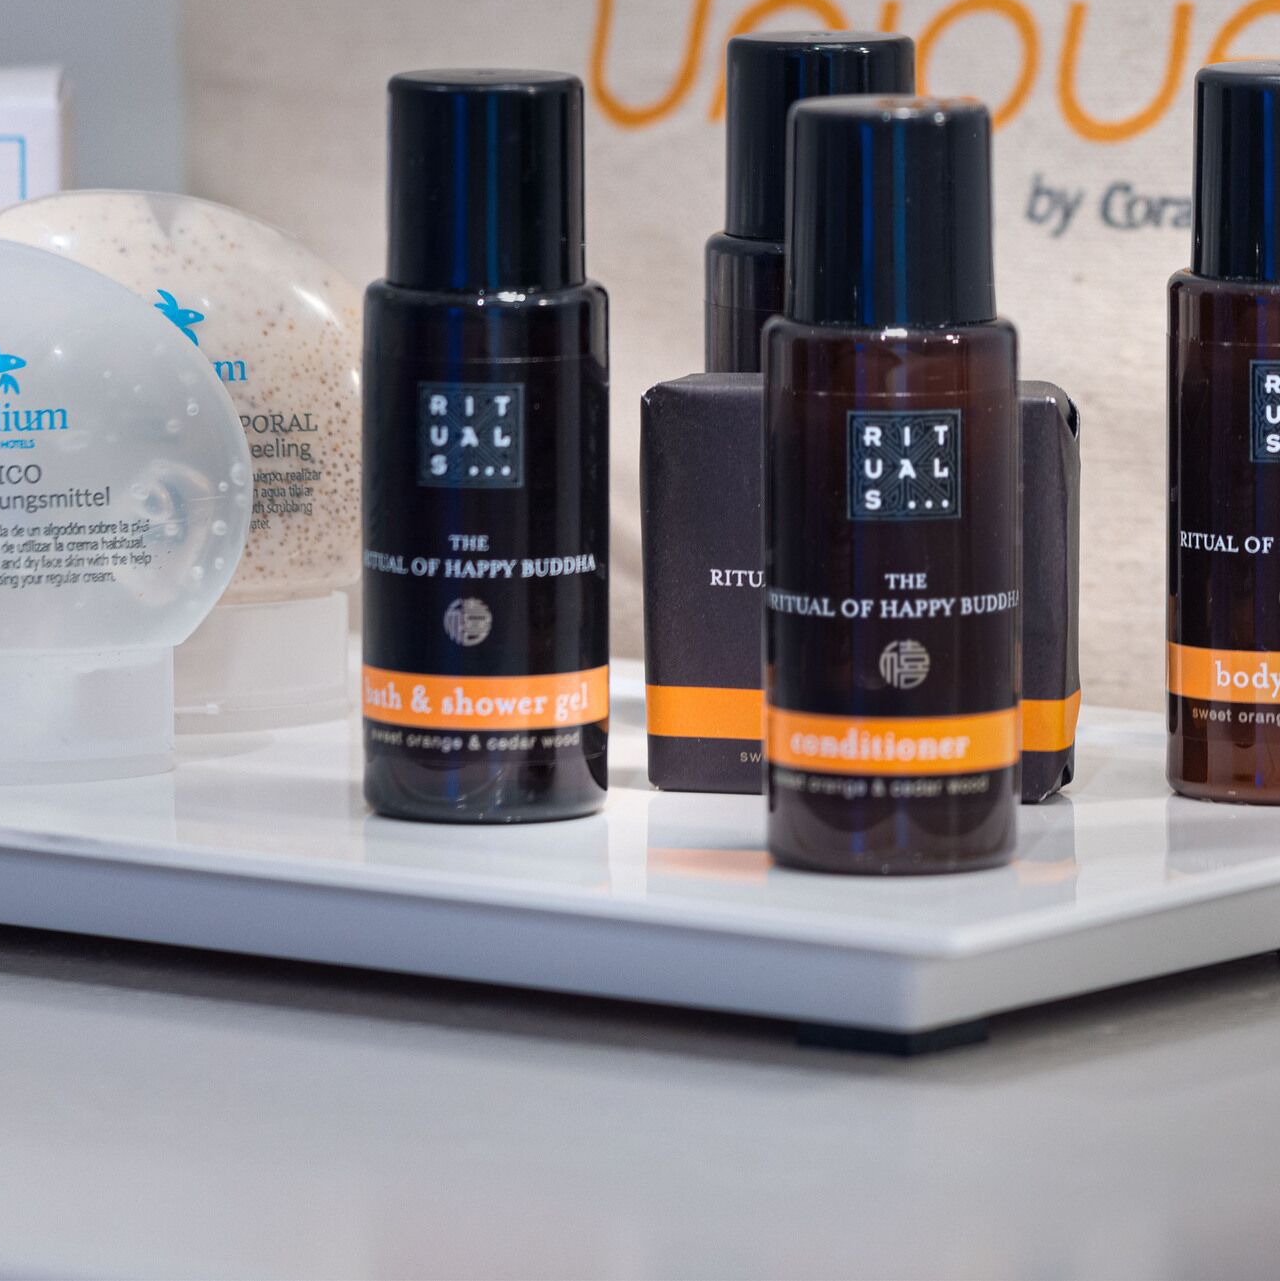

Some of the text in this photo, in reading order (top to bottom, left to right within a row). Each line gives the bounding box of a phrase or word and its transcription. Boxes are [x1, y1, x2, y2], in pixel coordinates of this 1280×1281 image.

[1025, 172, 1085, 238] by
[448, 534, 489, 551] THE
[1180, 531, 1239, 552] RITUAL
[1244, 537, 1273, 554] OF
[411, 557, 440, 577] OF
[444, 559, 519, 578] HAPPY
[521, 553, 596, 578] BUDDHA
[710, 569, 768, 587] RITU
[884, 573, 927, 589] THE
[841, 598, 873, 618] OF
[880, 598, 955, 618] HAPPY
[411, 684, 432, 714] &
[441, 686, 548, 716] shower
[555, 682, 588, 721] gel
[1192, 707, 1232, 722] sweet
[790, 728, 969, 761] conditioner
